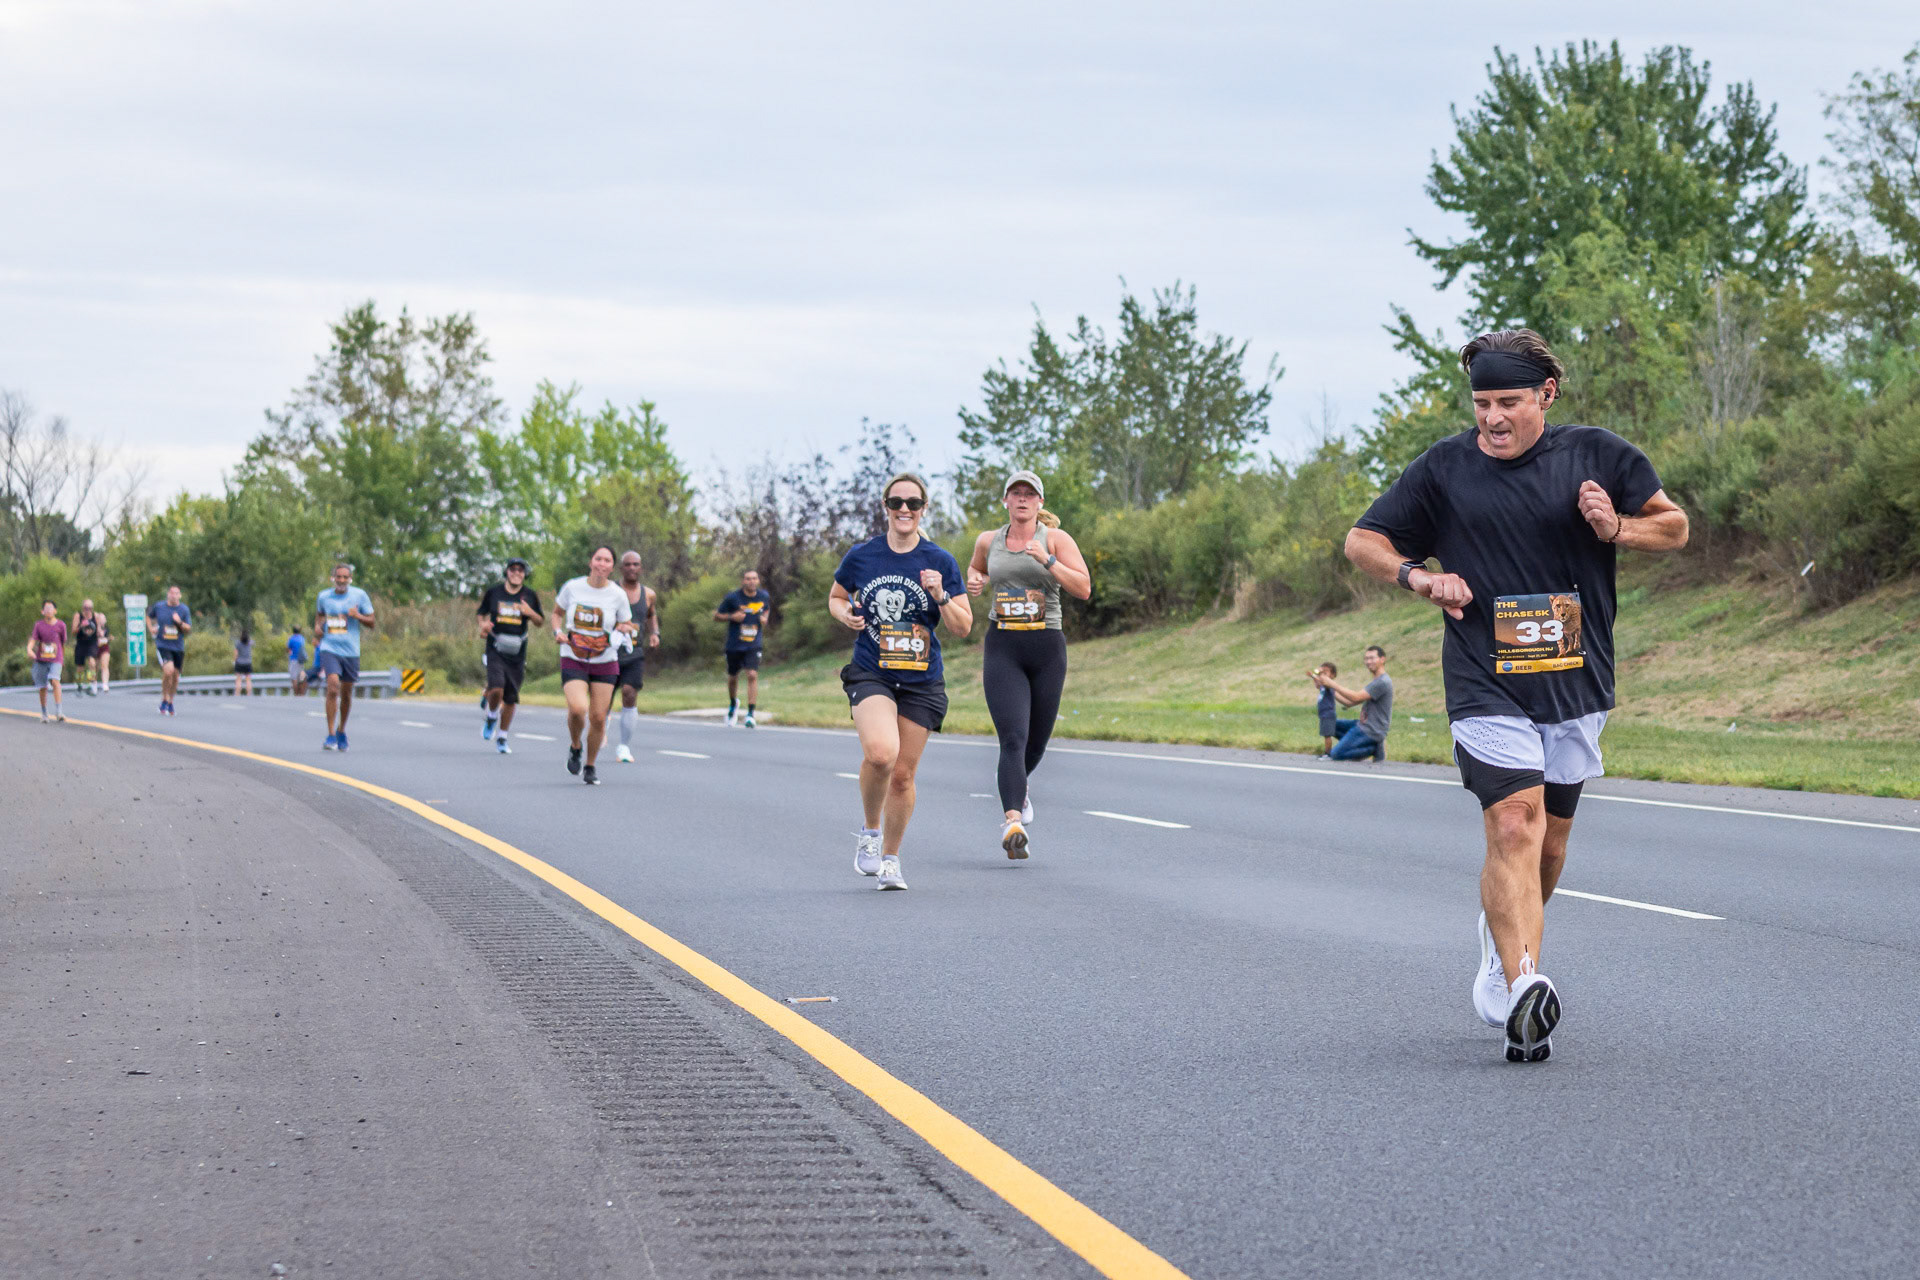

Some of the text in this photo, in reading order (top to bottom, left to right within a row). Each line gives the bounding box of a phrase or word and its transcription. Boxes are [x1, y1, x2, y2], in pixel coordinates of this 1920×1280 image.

[903, 577, 929, 612] DENTISTRY
[1001, 602, 1039, 616] 133
[1496, 609, 1550, 619] CHASE 5K
[1516, 620, 1564, 643] 33
[885, 637, 925, 652] 149
